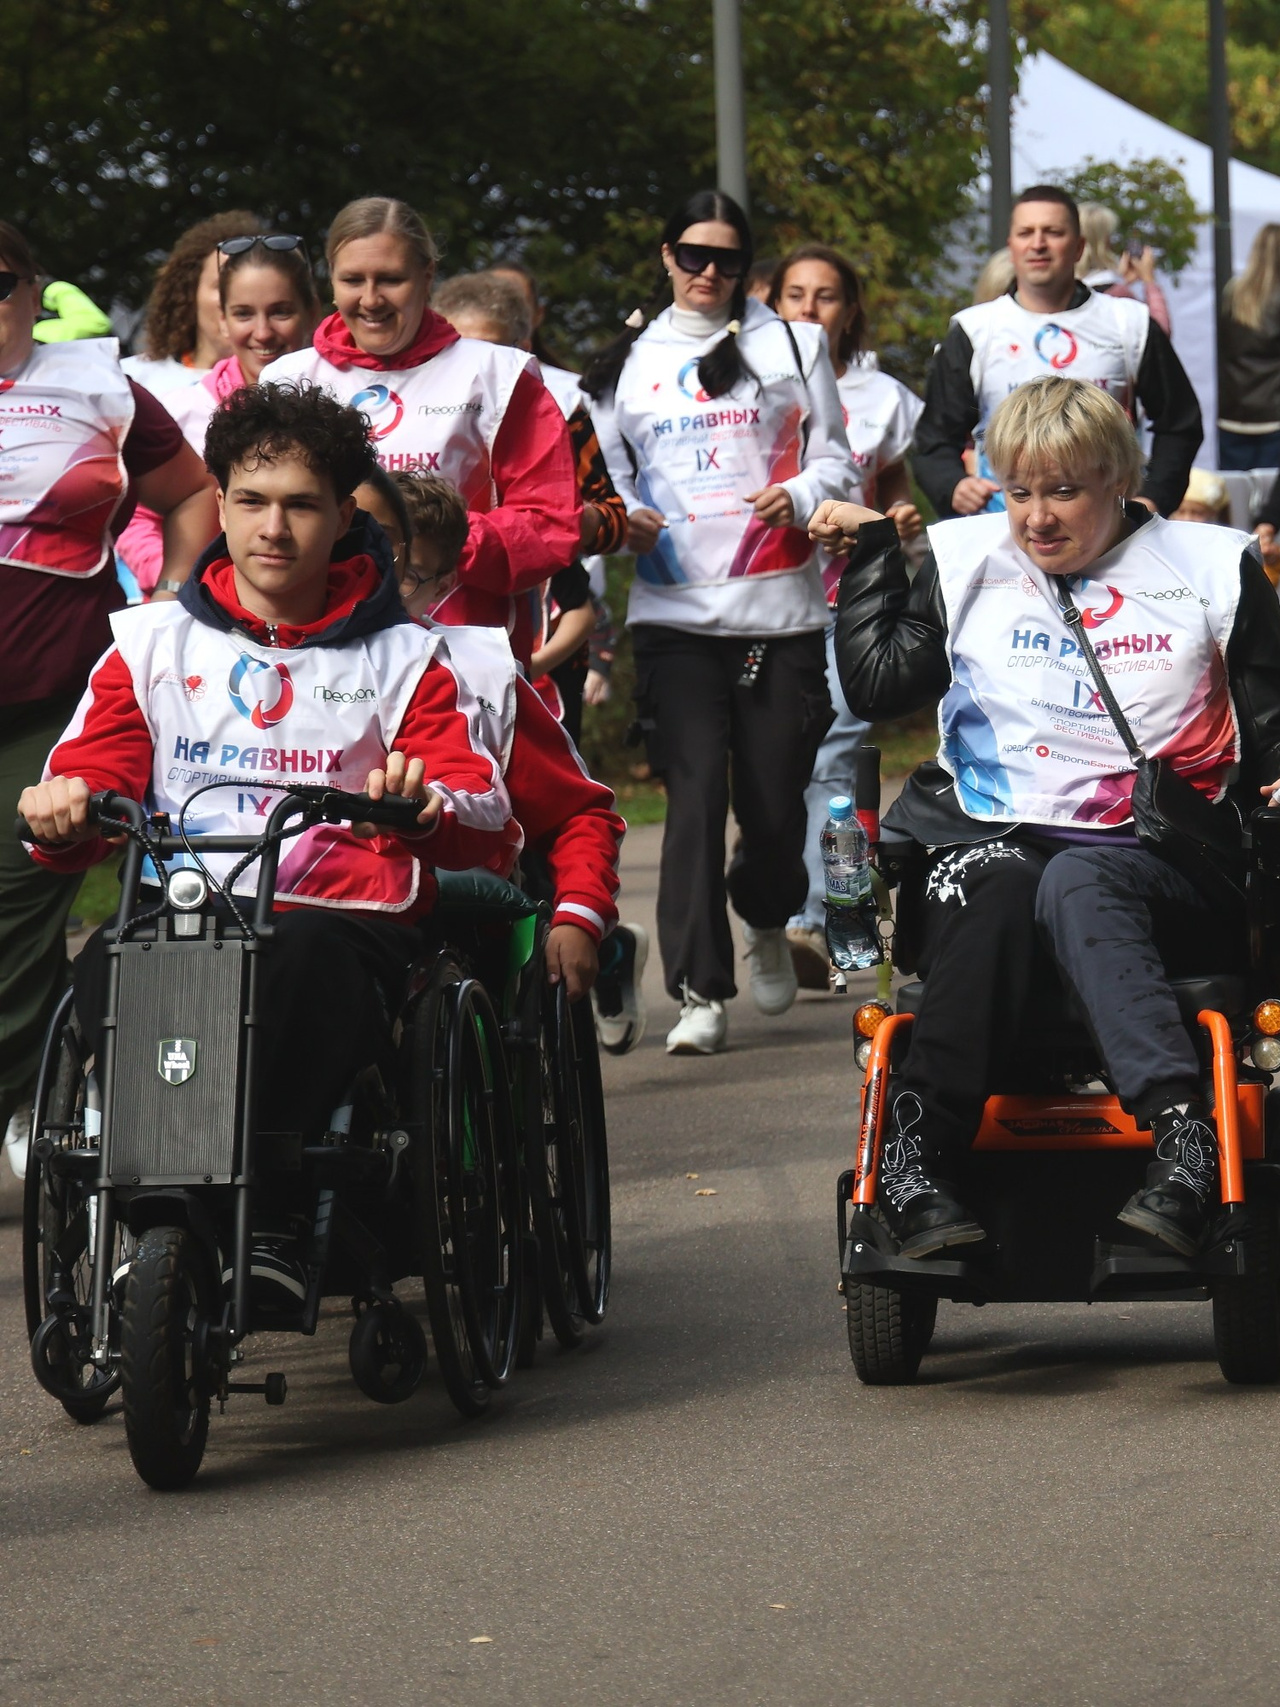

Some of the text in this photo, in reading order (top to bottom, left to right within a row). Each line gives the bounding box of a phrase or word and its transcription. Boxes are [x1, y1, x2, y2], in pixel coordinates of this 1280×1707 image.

[652, 408, 760, 438] НА РАВНЫХ
[696, 447, 721, 471] IX
[1012, 629, 1050, 651] НА
[1072, 680, 1106, 713] IX
[1031, 697, 1142, 726] БЛАГОТВОРИТЕЛЫЙ
[1054, 724, 1115, 746] ФЕСТИВАЛЬ
[173, 735, 344, 773] НА РАВНЫХ
[237, 793, 273, 816] IX
